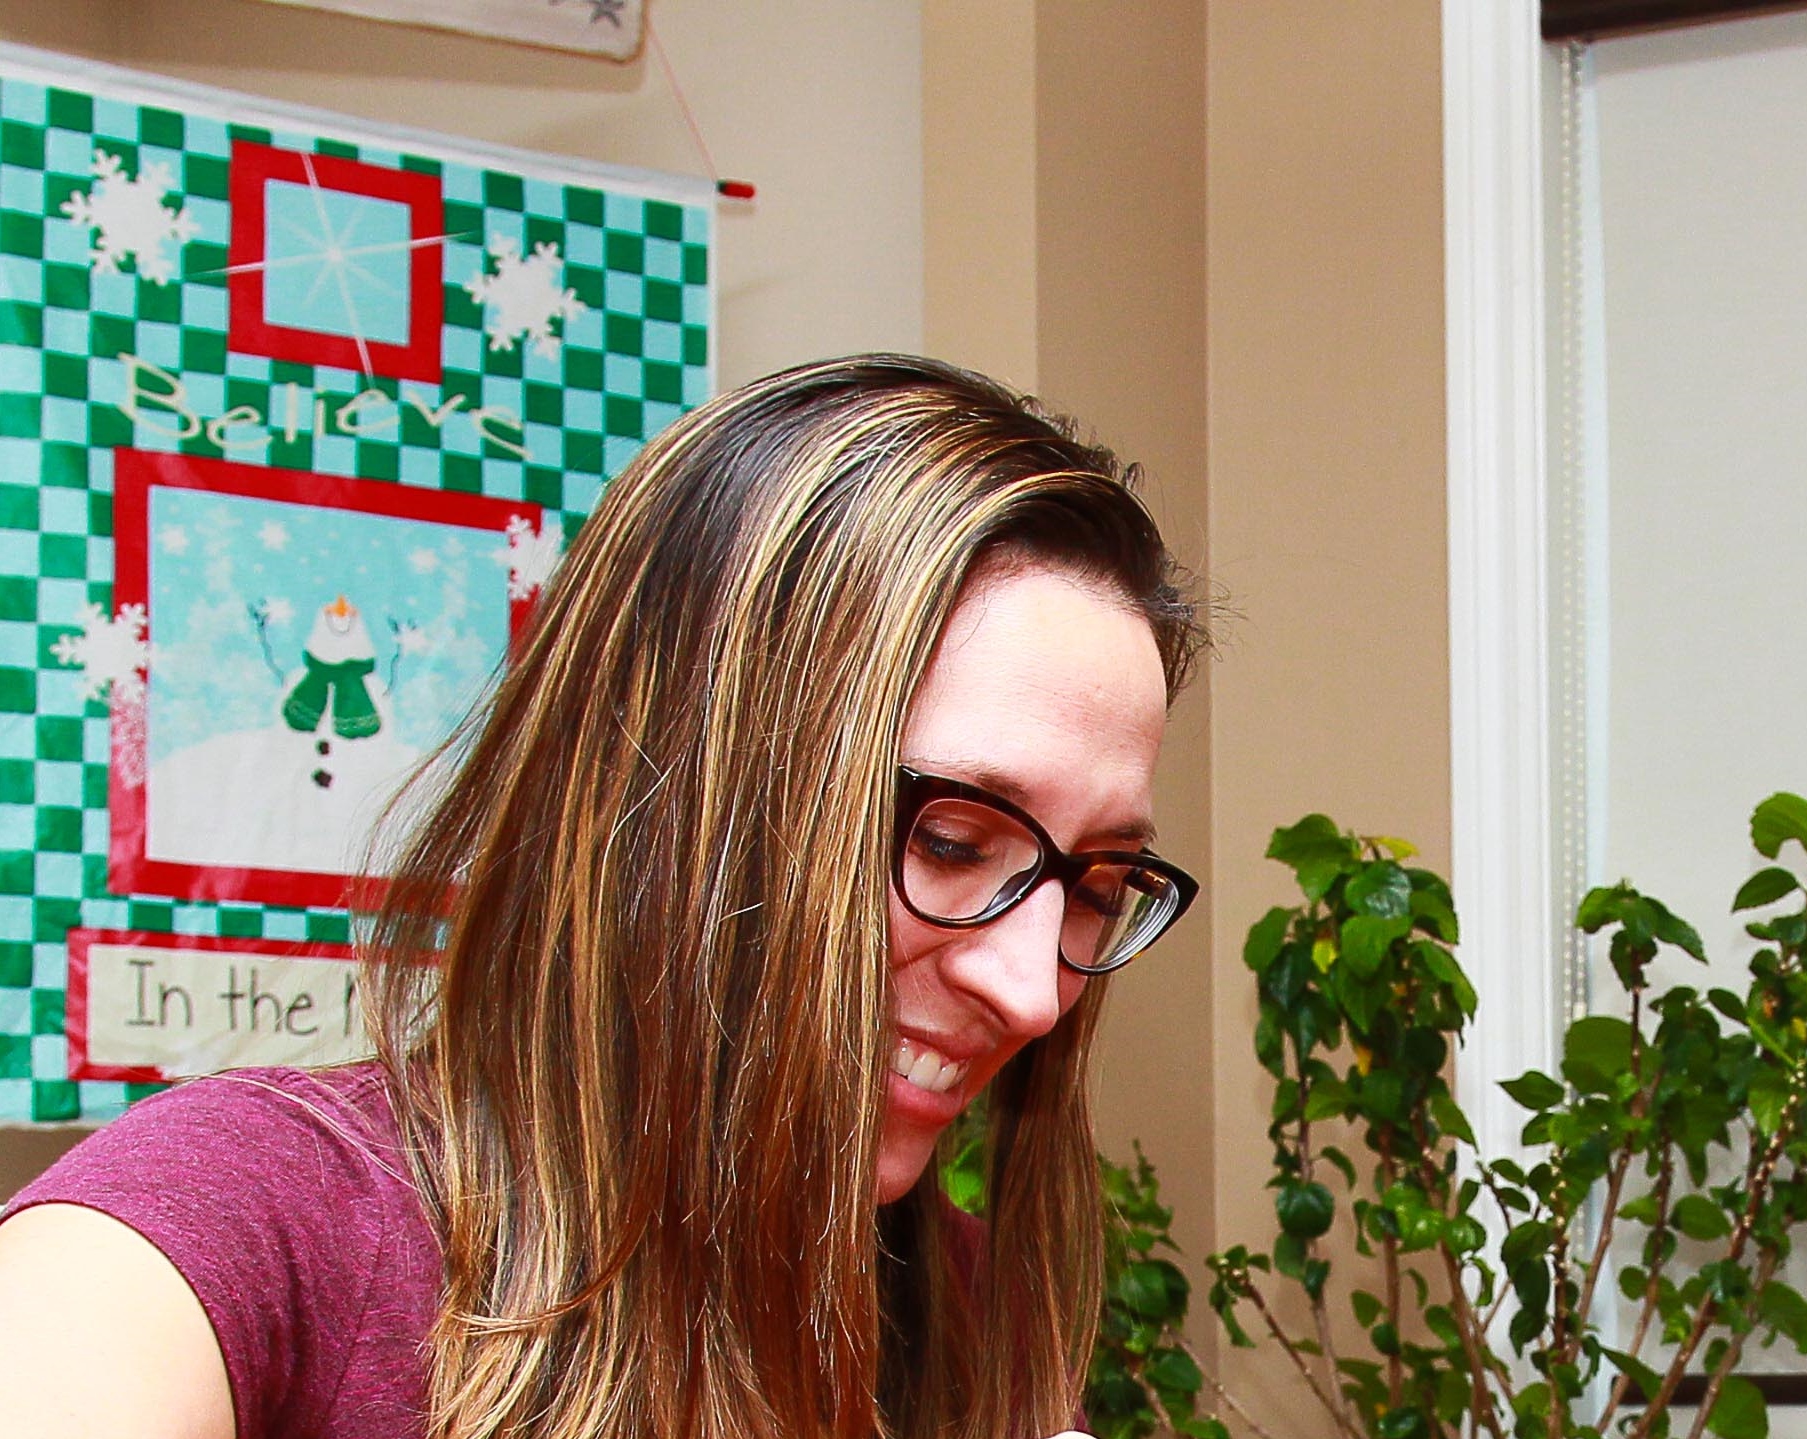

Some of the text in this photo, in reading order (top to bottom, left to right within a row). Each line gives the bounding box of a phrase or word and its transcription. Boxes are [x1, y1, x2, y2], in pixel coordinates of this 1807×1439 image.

[117, 353, 532, 462] Believe
[125, 959, 194, 1028] In
[220, 964, 318, 1038] the
